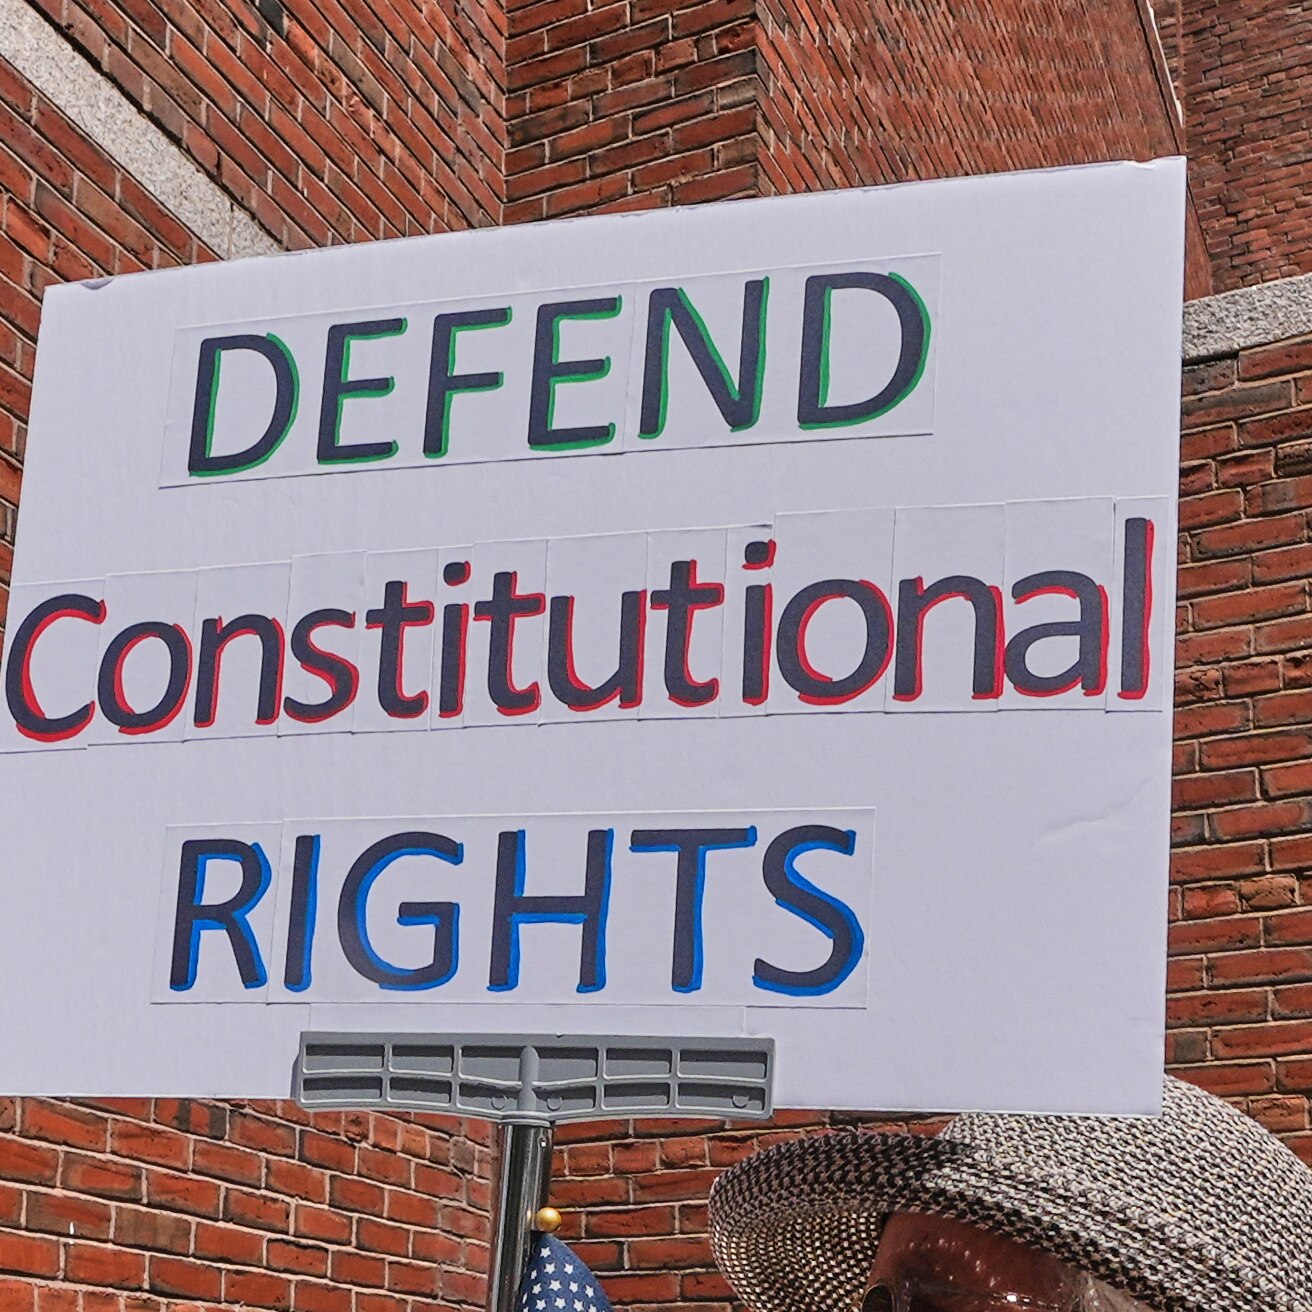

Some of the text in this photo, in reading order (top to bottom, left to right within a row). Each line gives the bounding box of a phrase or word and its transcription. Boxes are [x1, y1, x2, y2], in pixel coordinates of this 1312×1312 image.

[186, 270, 933, 478] DEFEND
[2, 515, 1157, 743] Constitutional
[167, 824, 865, 993] RIGHTS
